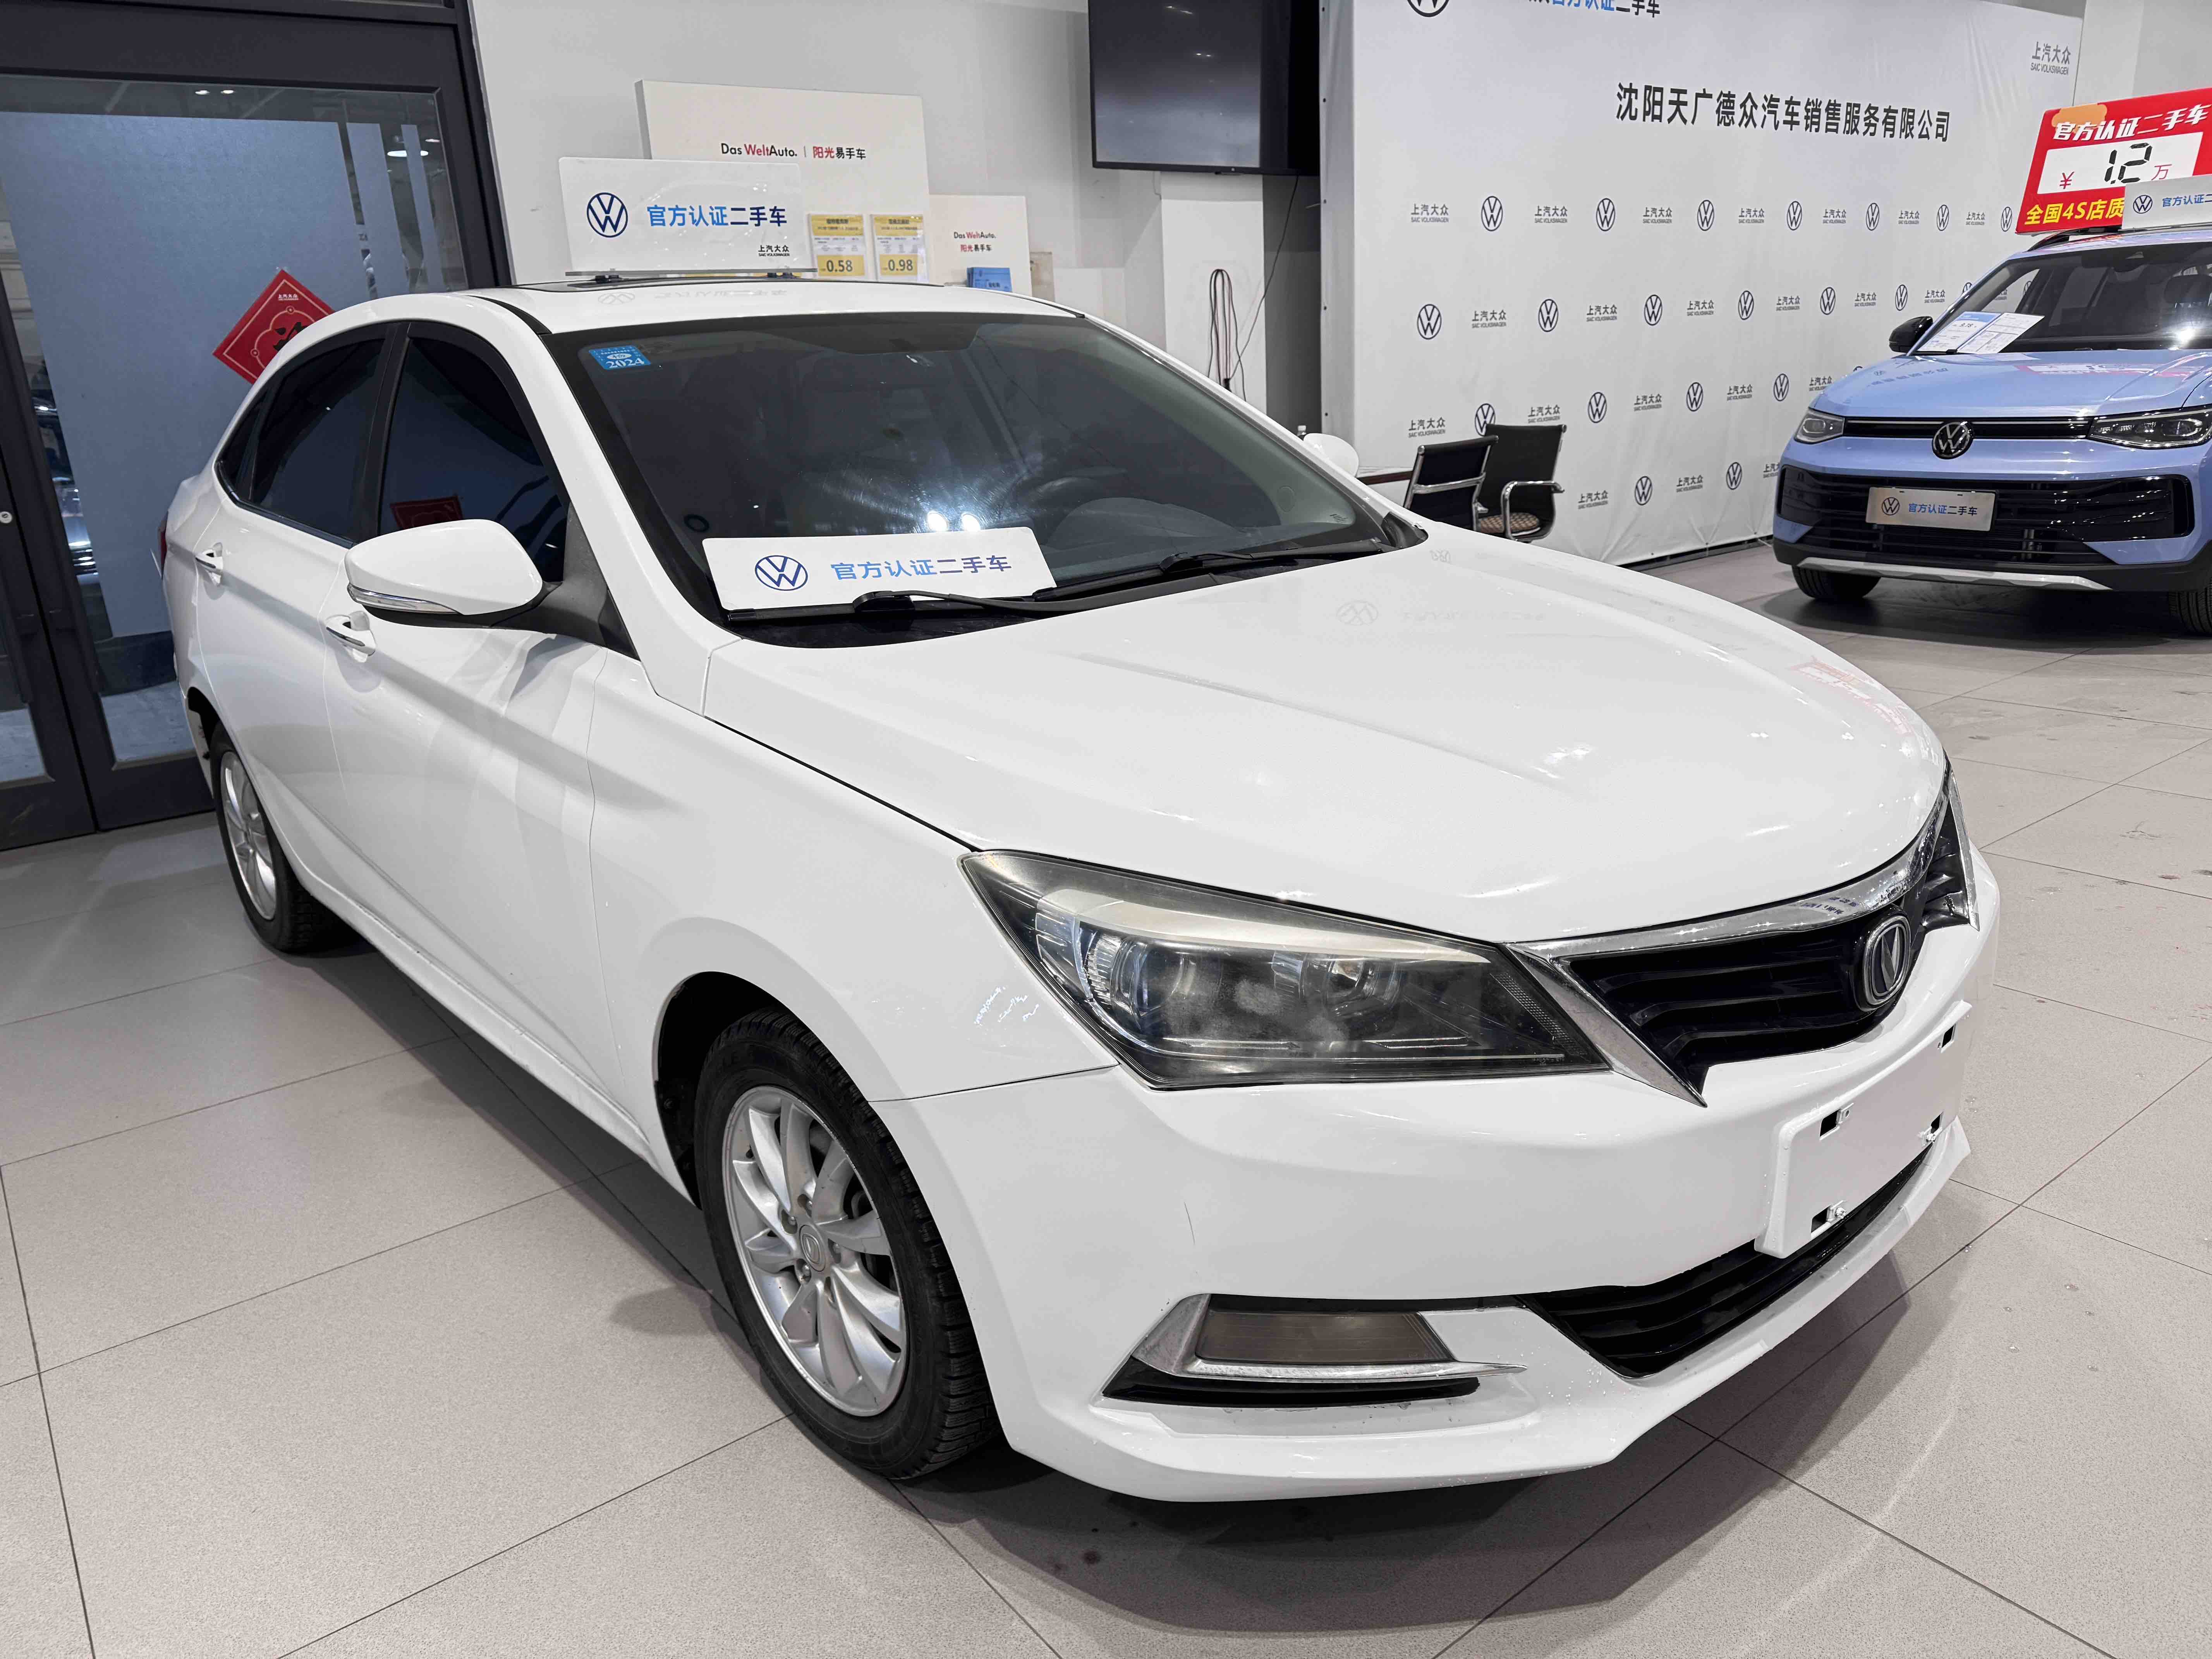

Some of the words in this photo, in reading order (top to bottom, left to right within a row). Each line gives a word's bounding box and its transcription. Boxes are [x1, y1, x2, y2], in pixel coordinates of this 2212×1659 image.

[2032, 41, 2071, 65] 上汽大众
[1616, 82, 1949, 142] 沈阳天广德众汽车销售服务有限公司
[2053, 104, 2211, 141] 官方认证二手车
[721, 143, 742, 155] Das
[744, 144, 797, 157] WeltAuto.
[813, 146, 866, 159] 阳光易手车
[2151, 164, 2172, 180] 万
[646, 205, 788, 227] 官方认证二手车
[1411, 203, 1448, 216] 上汽大众
[1534, 206, 1568, 217] 上汽大众
[1643, 207, 1672, 218] 上汽大众
[1738, 208, 1764, 218] 上汽大众
[826, 260, 853, 272] 0.58
[888, 259, 913, 271] 0.98
[1586, 304, 1617, 315] 上汽大众
[1687, 300, 1714, 310] 上汽大众
[1472, 309, 1506, 321] 上汽大众
[606, 358, 644, 368] 2024
[1528, 404, 1560, 417] 上汽大众
[1408, 417, 1446, 431] 上汽大众
[1909, 503, 1977, 516] 官方认证二手车
[831, 555, 1012, 580] 官方认证二手车
